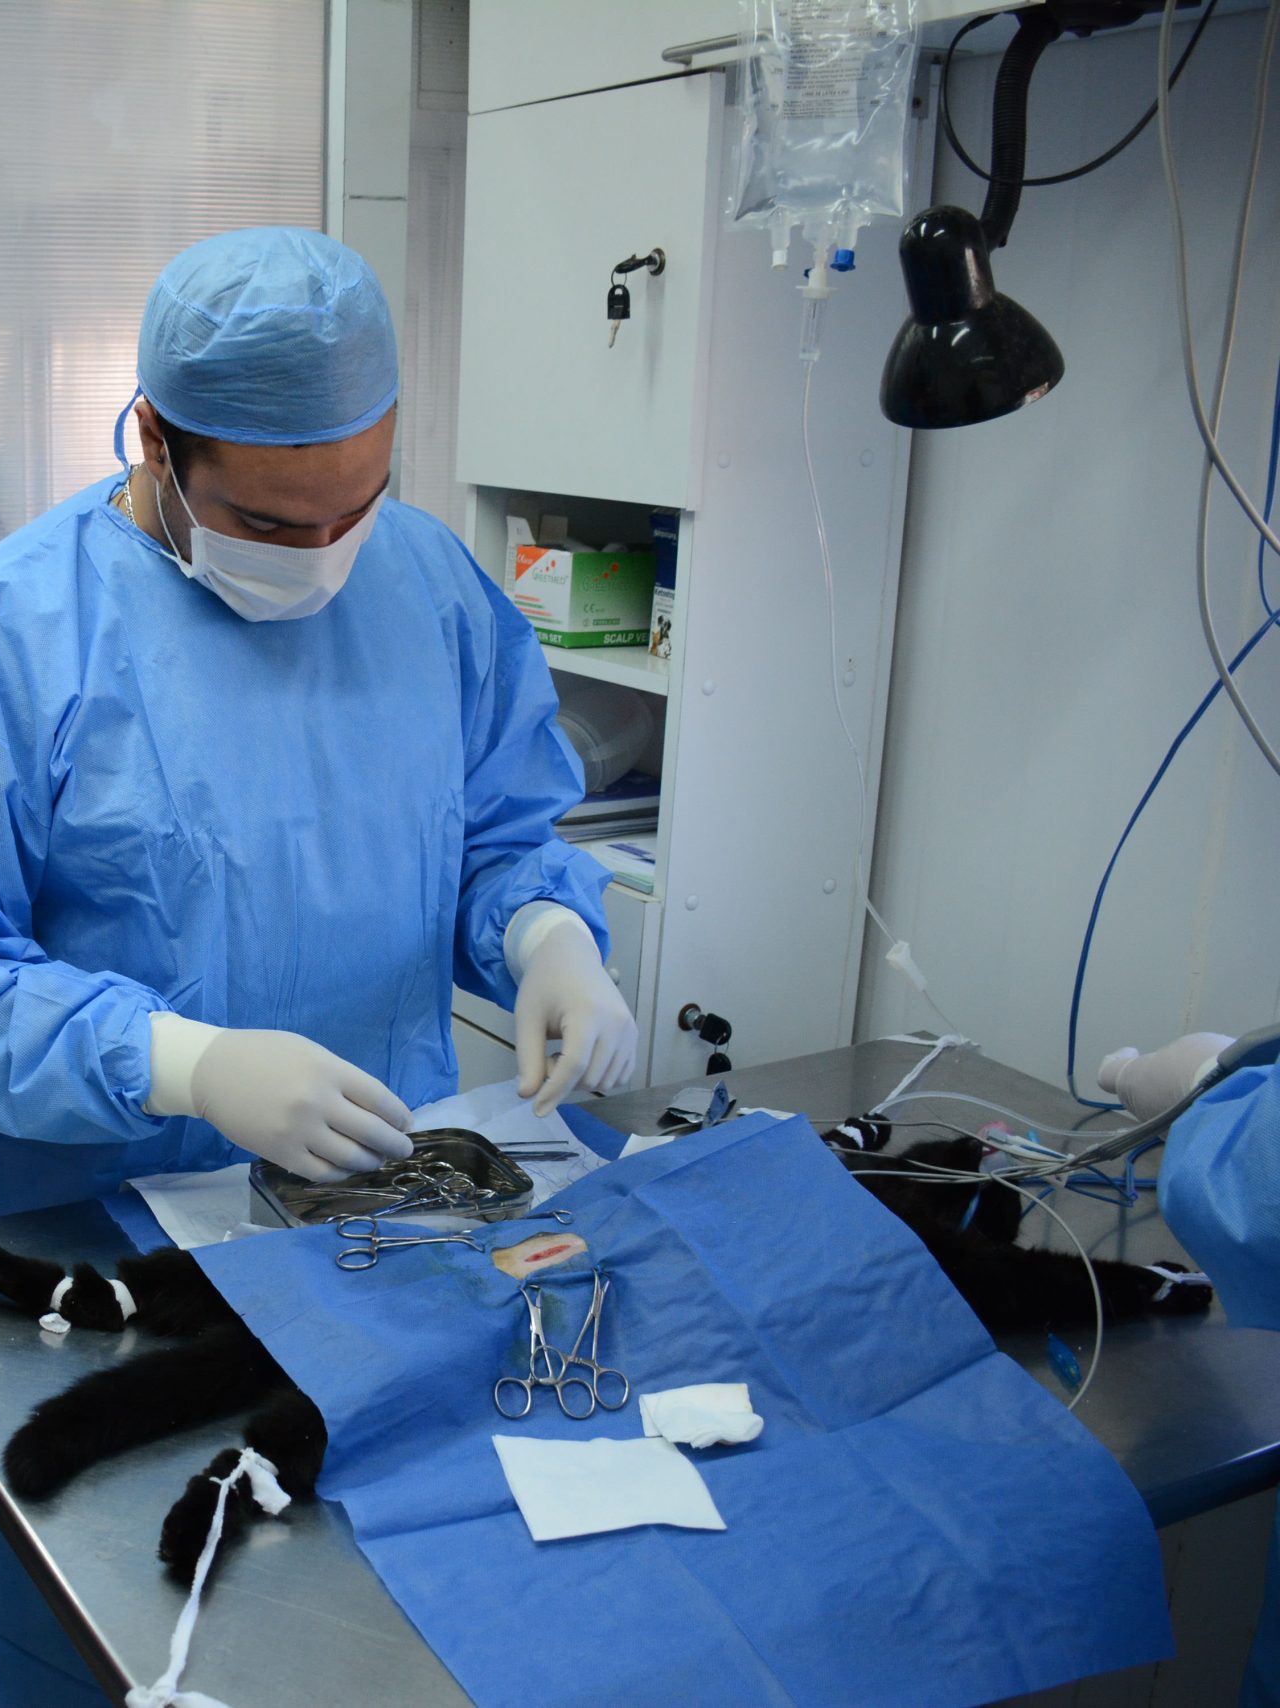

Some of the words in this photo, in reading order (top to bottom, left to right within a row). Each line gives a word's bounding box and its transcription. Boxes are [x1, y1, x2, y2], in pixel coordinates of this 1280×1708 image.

[550, 634, 562, 643] SET
[603, 633, 634, 644] SCALP
[635, 633, 647, 643] VE
